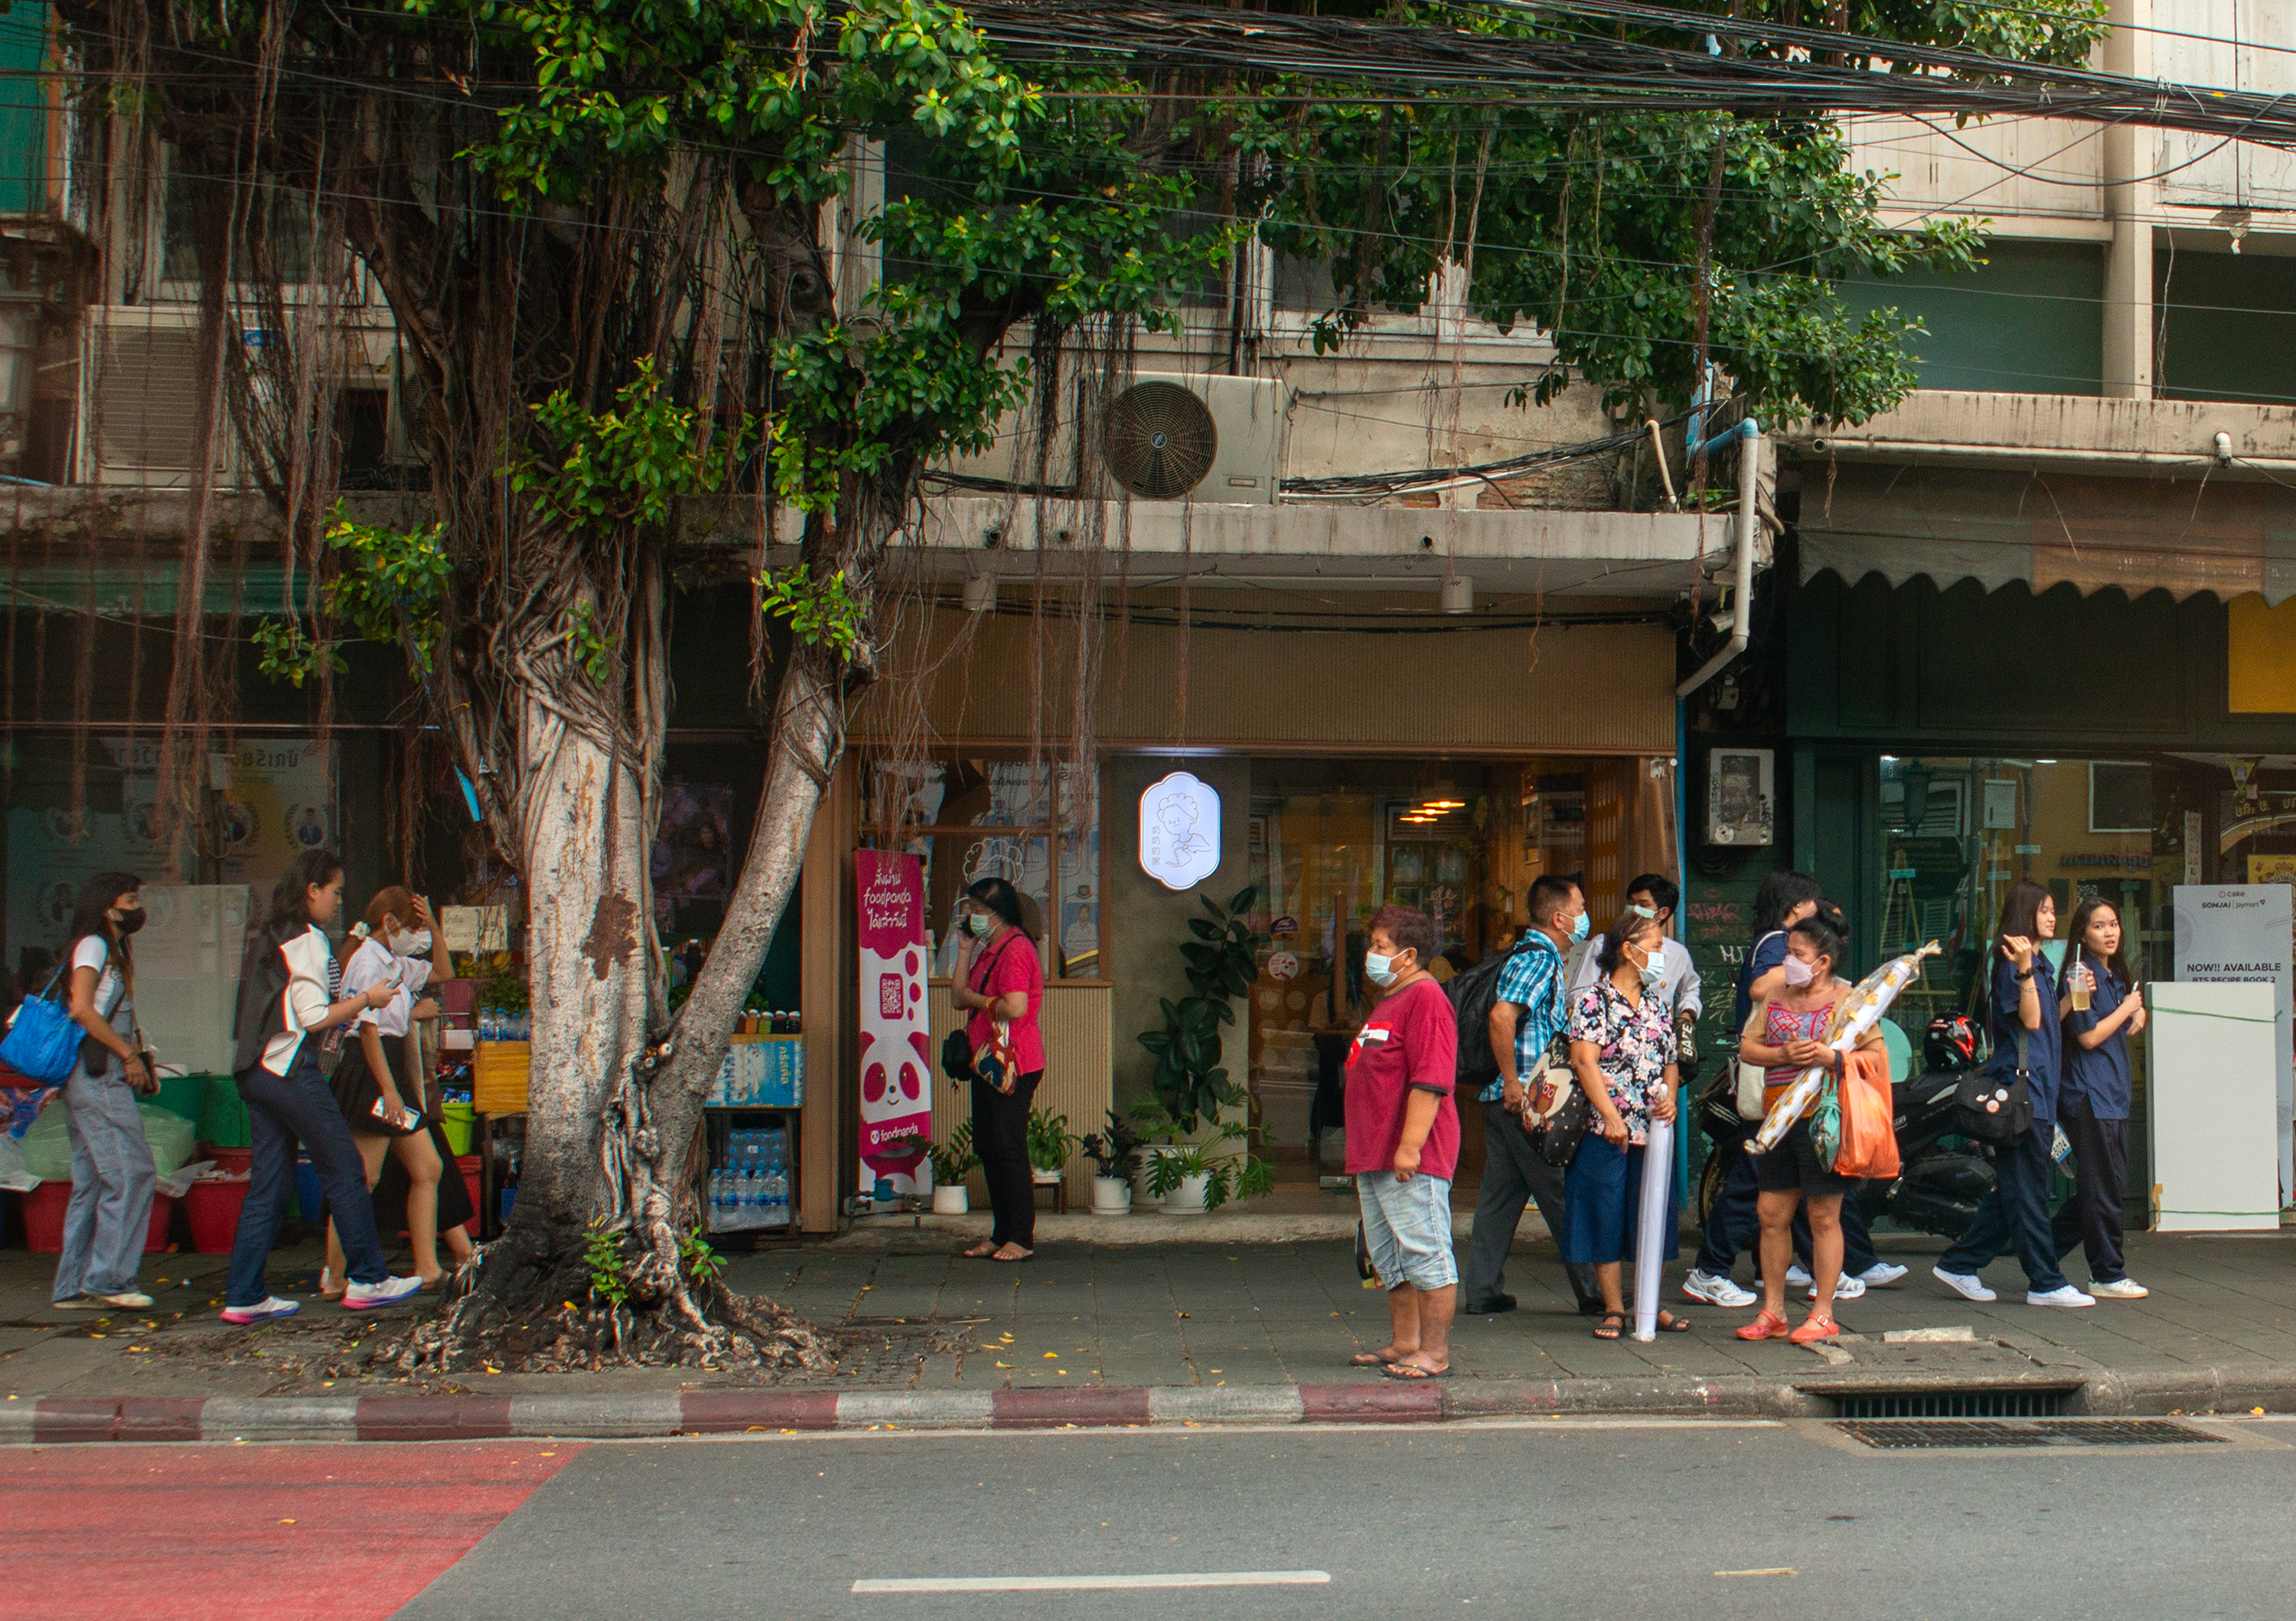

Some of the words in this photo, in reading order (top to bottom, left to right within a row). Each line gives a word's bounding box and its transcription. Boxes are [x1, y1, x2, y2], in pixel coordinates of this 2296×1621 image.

[863, 886, 912, 908] foodpanda
[2187, 963, 2220, 972] NOW!!
[2223, 962, 2281, 971] AVAILABLE
